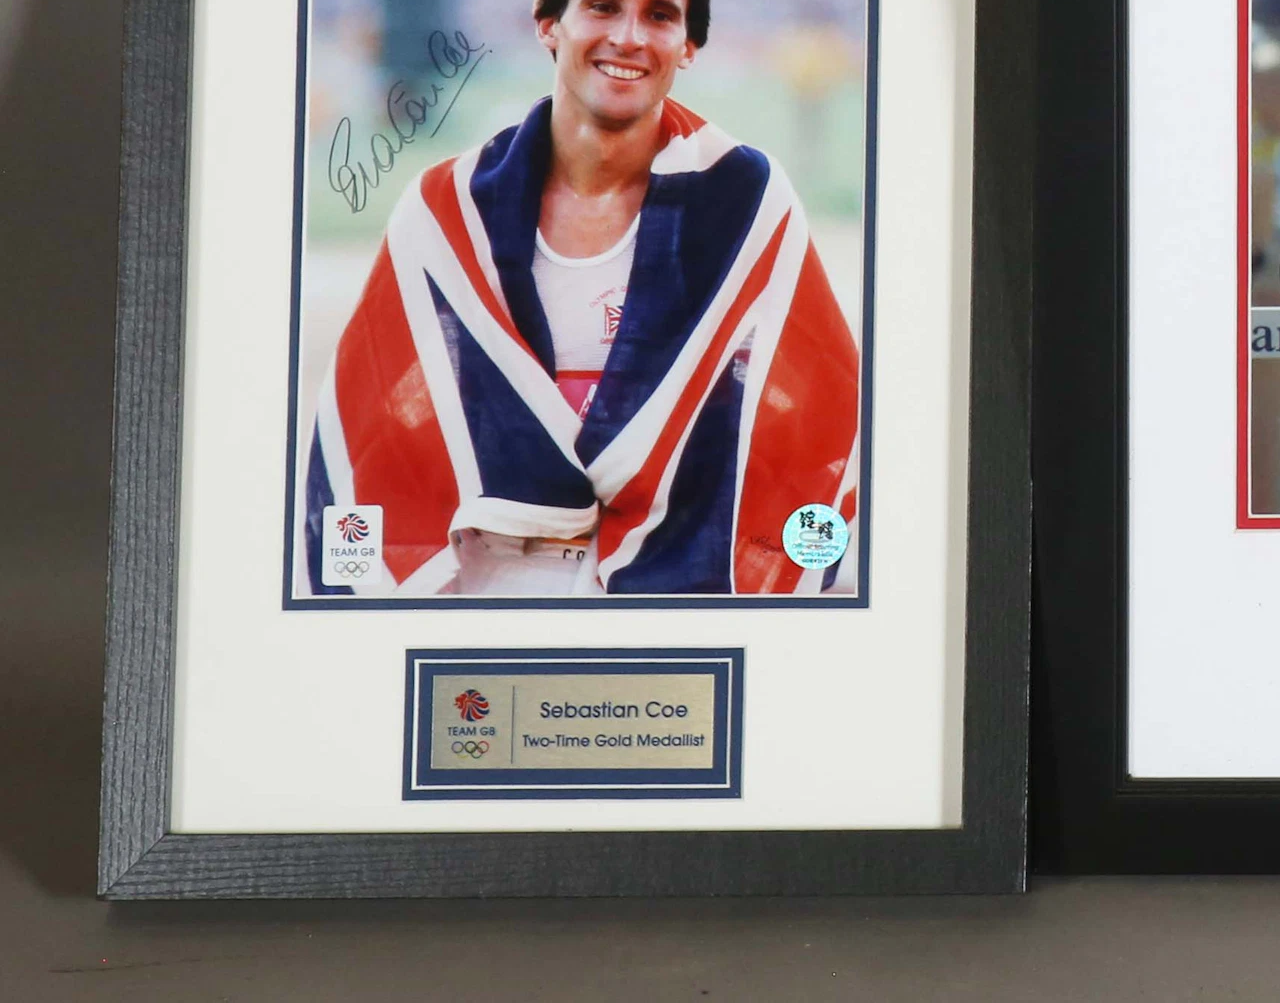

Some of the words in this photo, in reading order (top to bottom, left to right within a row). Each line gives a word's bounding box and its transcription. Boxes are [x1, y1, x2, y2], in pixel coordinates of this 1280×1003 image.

[330, 548, 358, 557] TEAM
[360, 547, 376, 557] GB
[539, 700, 639, 719] Sebastian
[645, 701, 688, 719] Coe
[447, 726, 477, 737] TEAM
[479, 726, 496, 737] GB
[522, 734, 590, 748] Two-Time
[594, 734, 632, 748] Gold
[636, 734, 705, 748] Medallist
